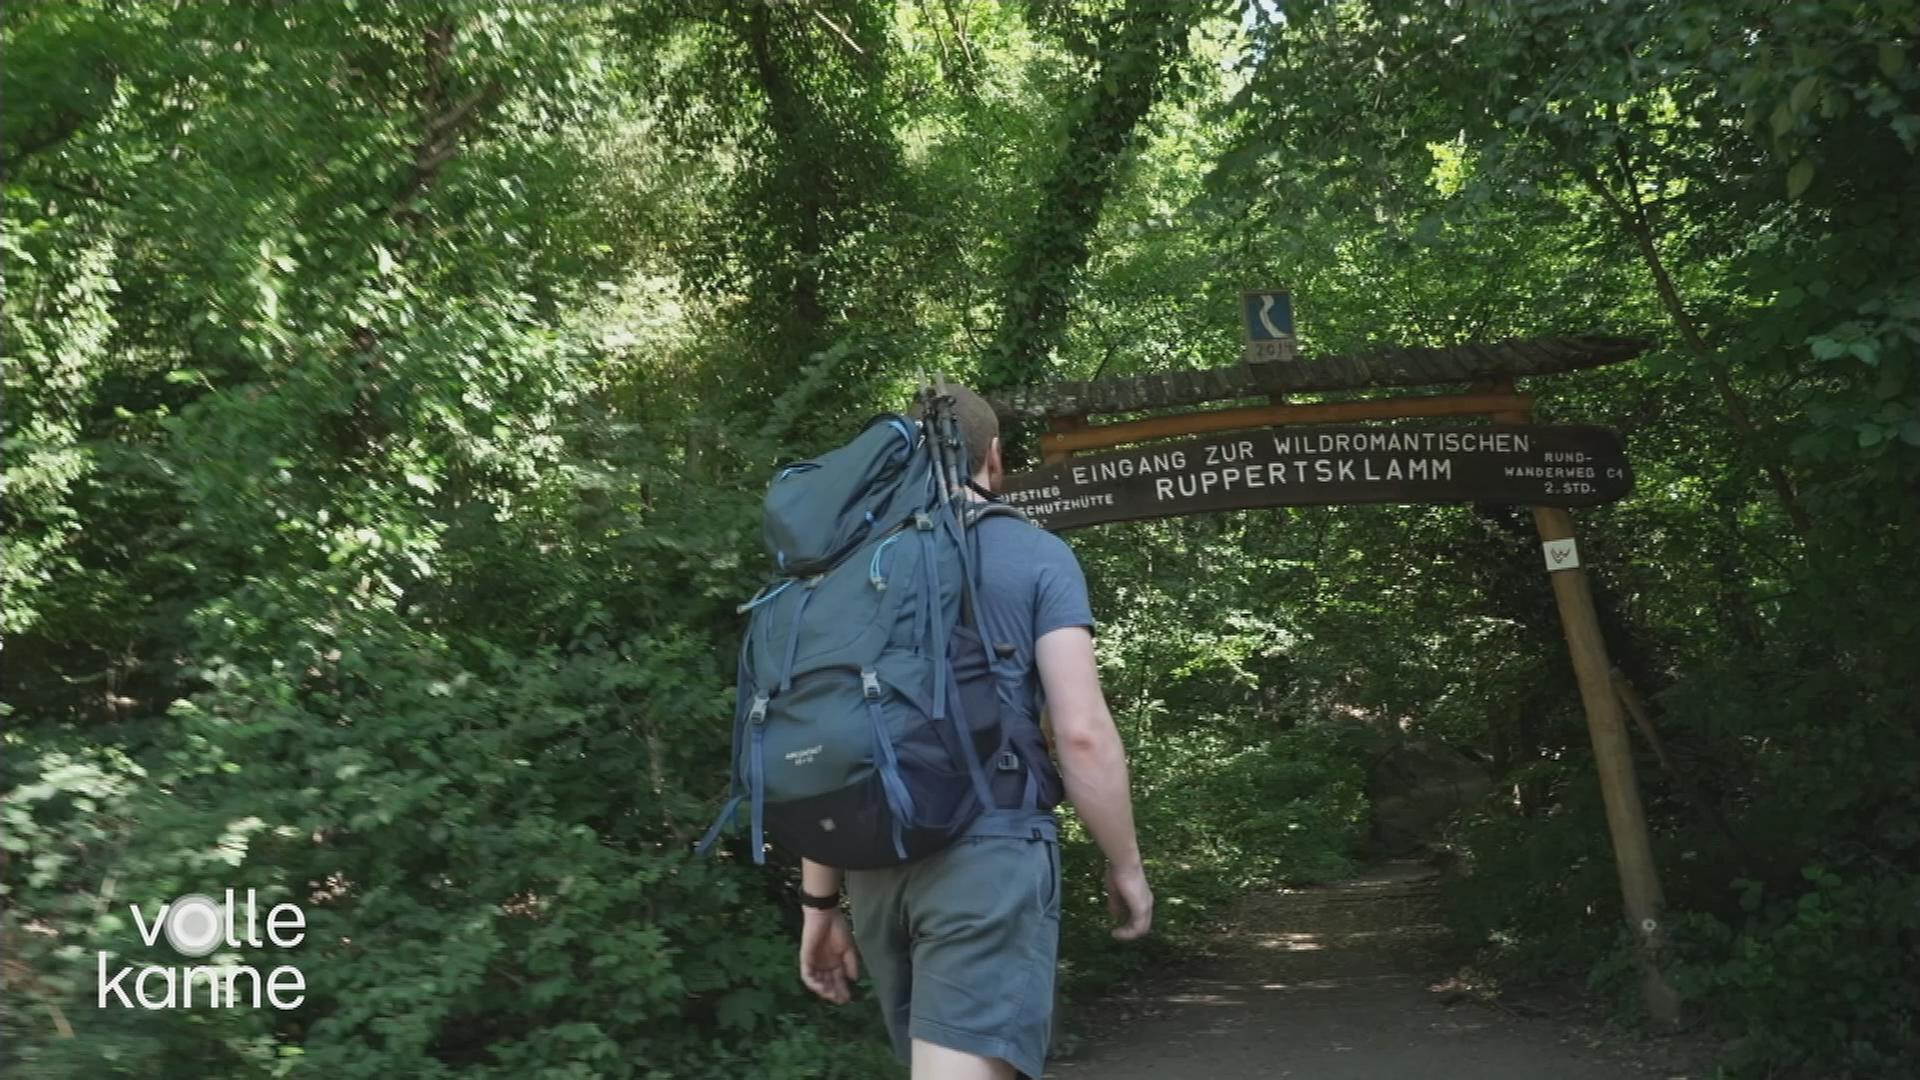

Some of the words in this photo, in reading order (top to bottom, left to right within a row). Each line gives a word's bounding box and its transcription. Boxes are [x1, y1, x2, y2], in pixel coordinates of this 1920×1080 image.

[1072, 451, 1186, 485] EINGANG
[1204, 440, 1254, 466] ZUR
[1274, 432, 1529, 455] WILDROMANTISCHEN
[1503, 466, 1596, 479] WANDERWEG
[1000, 485, 1061, 503] UFSTIEG
[1156, 458, 1452, 500] RUPPERTSKLAMM
